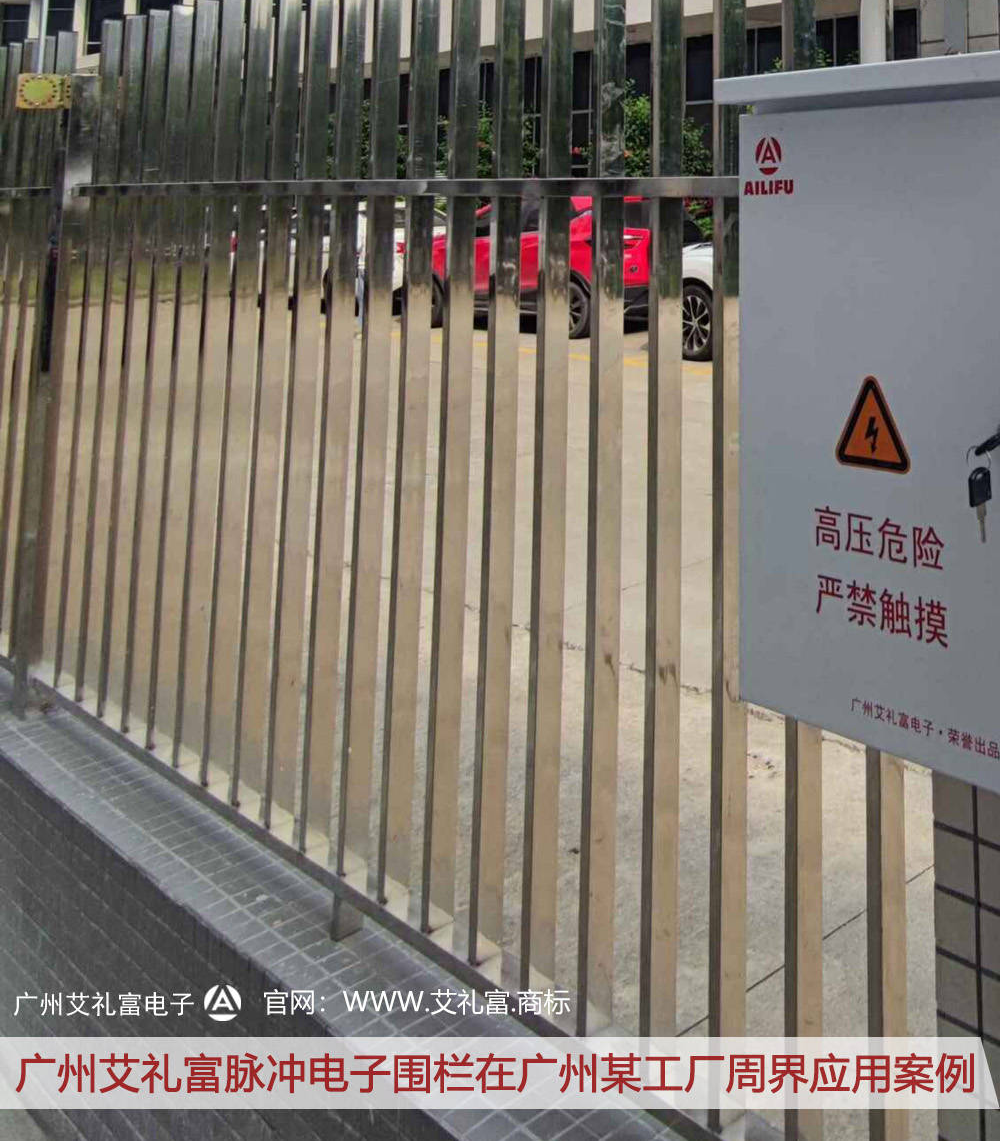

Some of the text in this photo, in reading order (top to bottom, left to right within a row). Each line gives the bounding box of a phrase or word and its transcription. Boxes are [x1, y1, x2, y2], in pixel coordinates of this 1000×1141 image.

[743, 179, 794, 196] AILIFU
[814, 506, 945, 571] 高压危险
[816, 574, 949, 648] 严禁触摸
